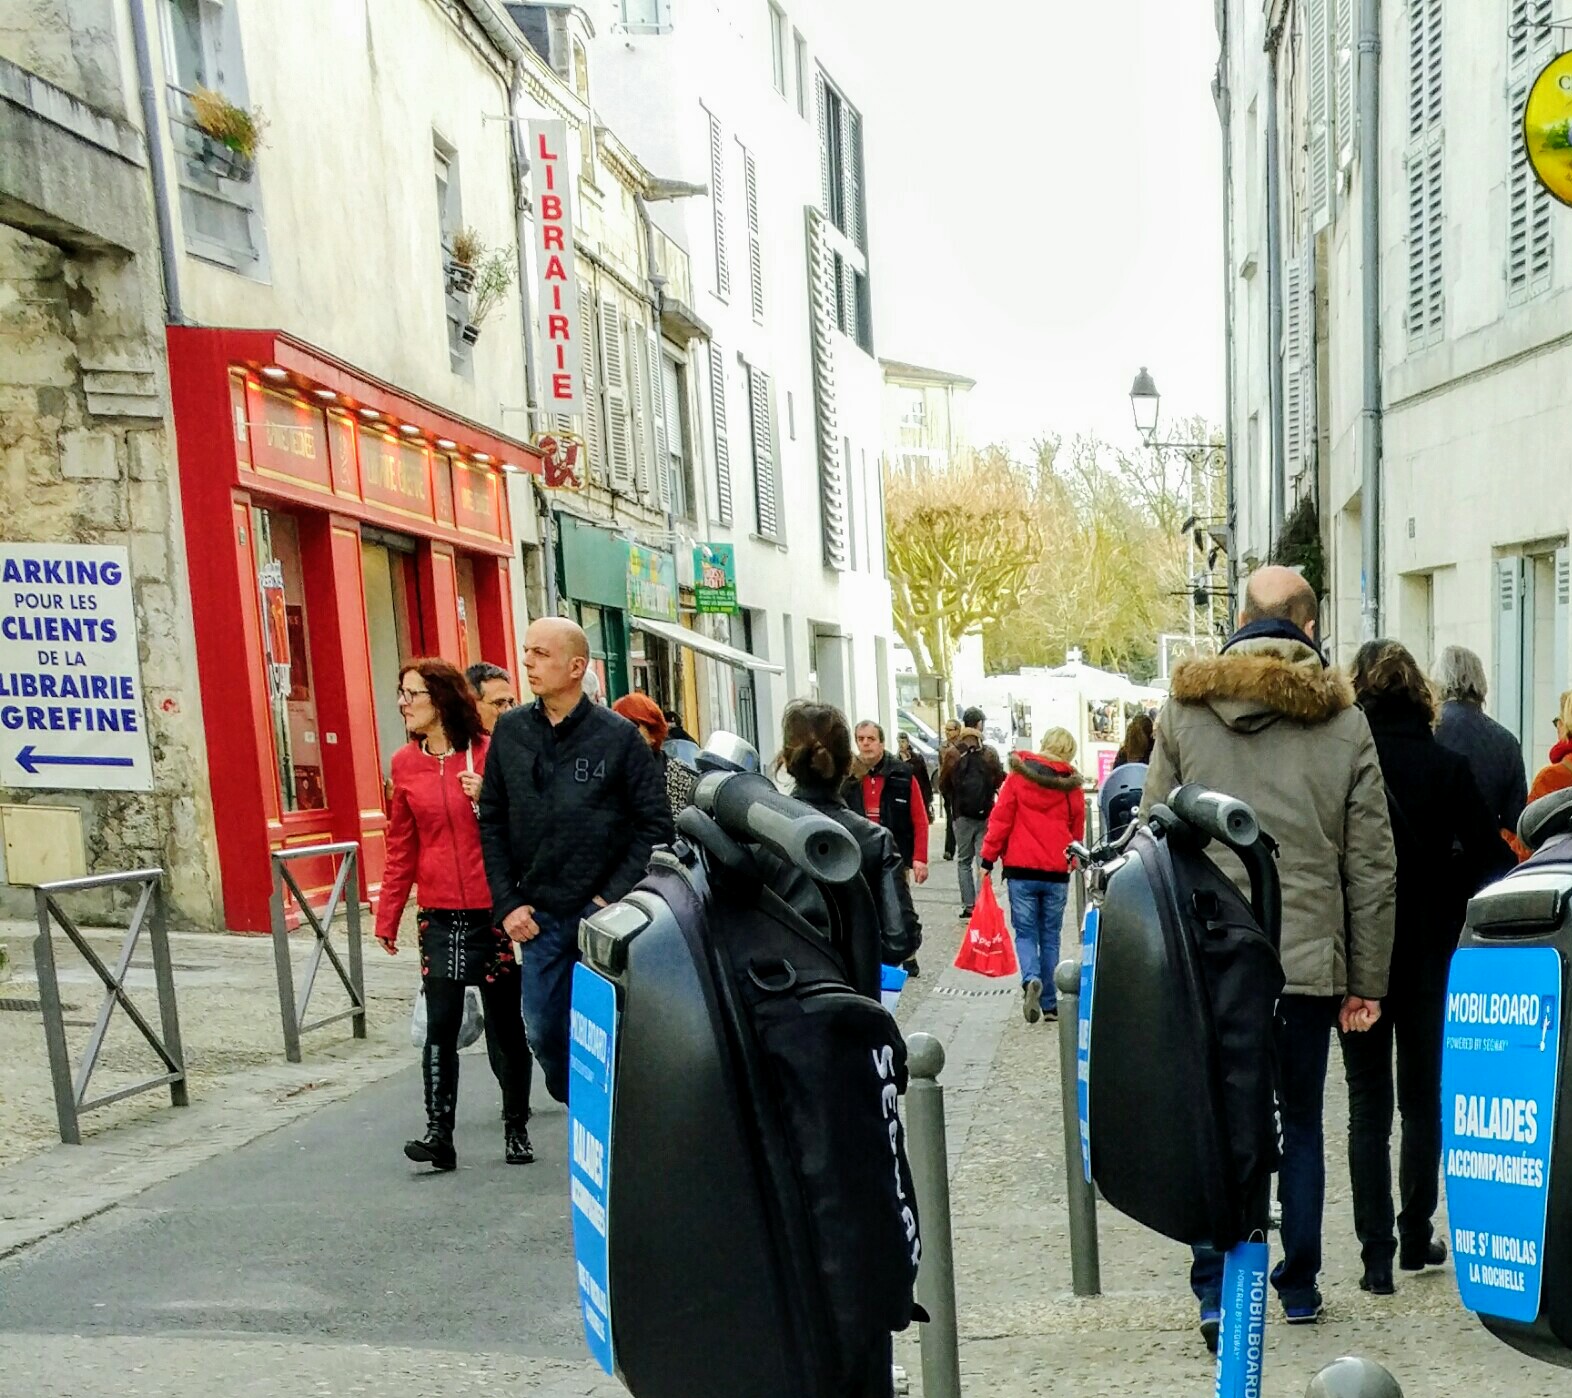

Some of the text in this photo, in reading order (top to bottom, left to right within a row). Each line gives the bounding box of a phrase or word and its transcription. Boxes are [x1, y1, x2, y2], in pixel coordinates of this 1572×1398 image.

[538, 133, 572, 400] LIBRAIRIE
[0, 558, 122, 586] ARKING
[14, 593, 97, 610] POUR LES
[1, 616, 118, 643] CLIENTS
[38, 651, 86, 667] DE LA
[0, 673, 134, 700] LIBRAIRIE
[1, 705, 138, 732] GREFINE
[575, 758, 606, 782] 84
[1448, 992, 1540, 1027] MOBILBOARD
[1454, 1093, 1538, 1145] BALADES
[1447, 1149, 1543, 1188] ACCOMPAGNÉES
[1455, 1228, 1476, 1256] RUE
[1492, 1235, 1537, 1266] NICOLAS
[1469, 1262, 1525, 1292] LA ROCHELLE
